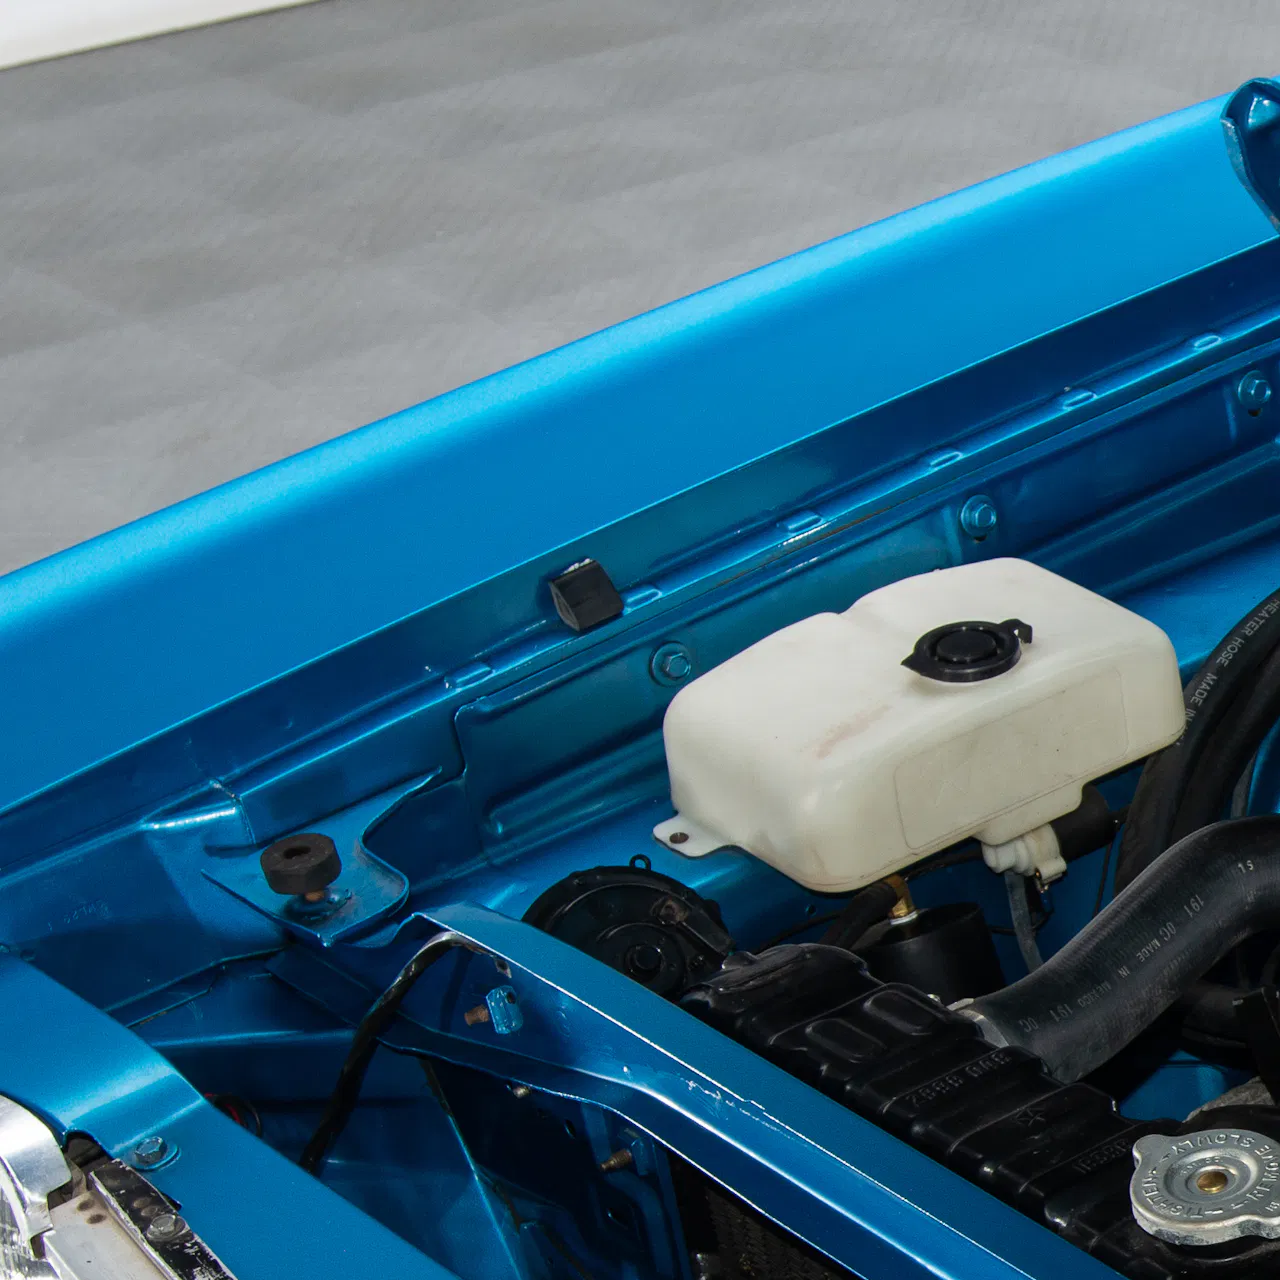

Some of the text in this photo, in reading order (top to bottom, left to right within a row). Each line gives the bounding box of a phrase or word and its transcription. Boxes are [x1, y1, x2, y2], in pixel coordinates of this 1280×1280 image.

[1216, 636, 1245, 668] HOSE
[1190, 672, 1218, 707] MADE
[1136, 938, 1162, 963] MADE
[1171, 1134, 1257, 1156] SLOWLY
[1251, 1144, 1280, 1202] REMOVE
[1142, 1176, 1205, 1219] TIGHTEN
